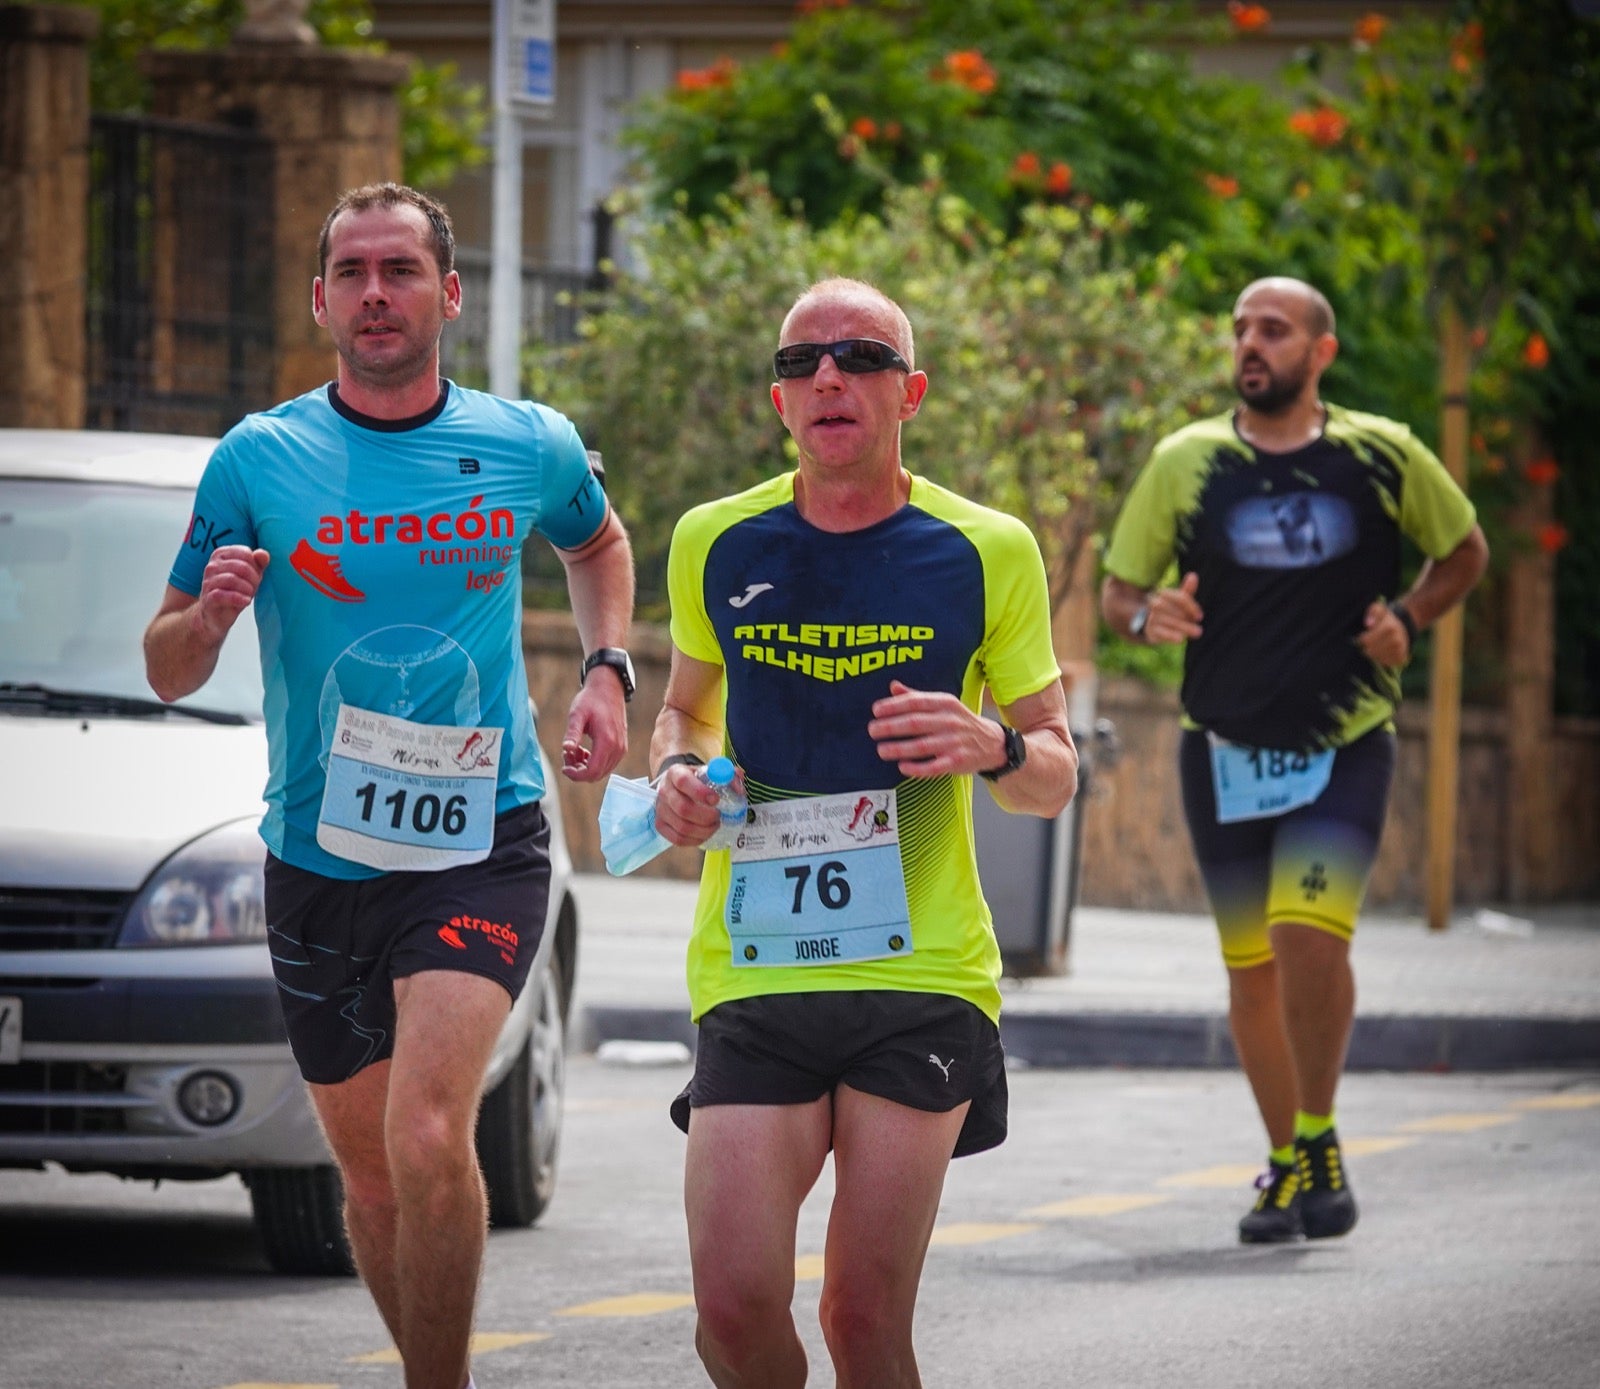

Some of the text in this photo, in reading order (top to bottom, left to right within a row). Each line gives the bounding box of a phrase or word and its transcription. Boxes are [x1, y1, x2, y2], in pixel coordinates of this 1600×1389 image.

[317, 495, 515, 545] atracón
[419, 543, 513, 567] running
[734, 623, 935, 648] ATLETISMO
[742, 643, 924, 683] ALHENDÍN
[355, 781, 468, 836] 1106
[731, 886, 746, 925] MASTER
[784, 860, 852, 915] 76
[450, 914, 519, 947] atracón
[795, 937, 841, 960] JORGE
